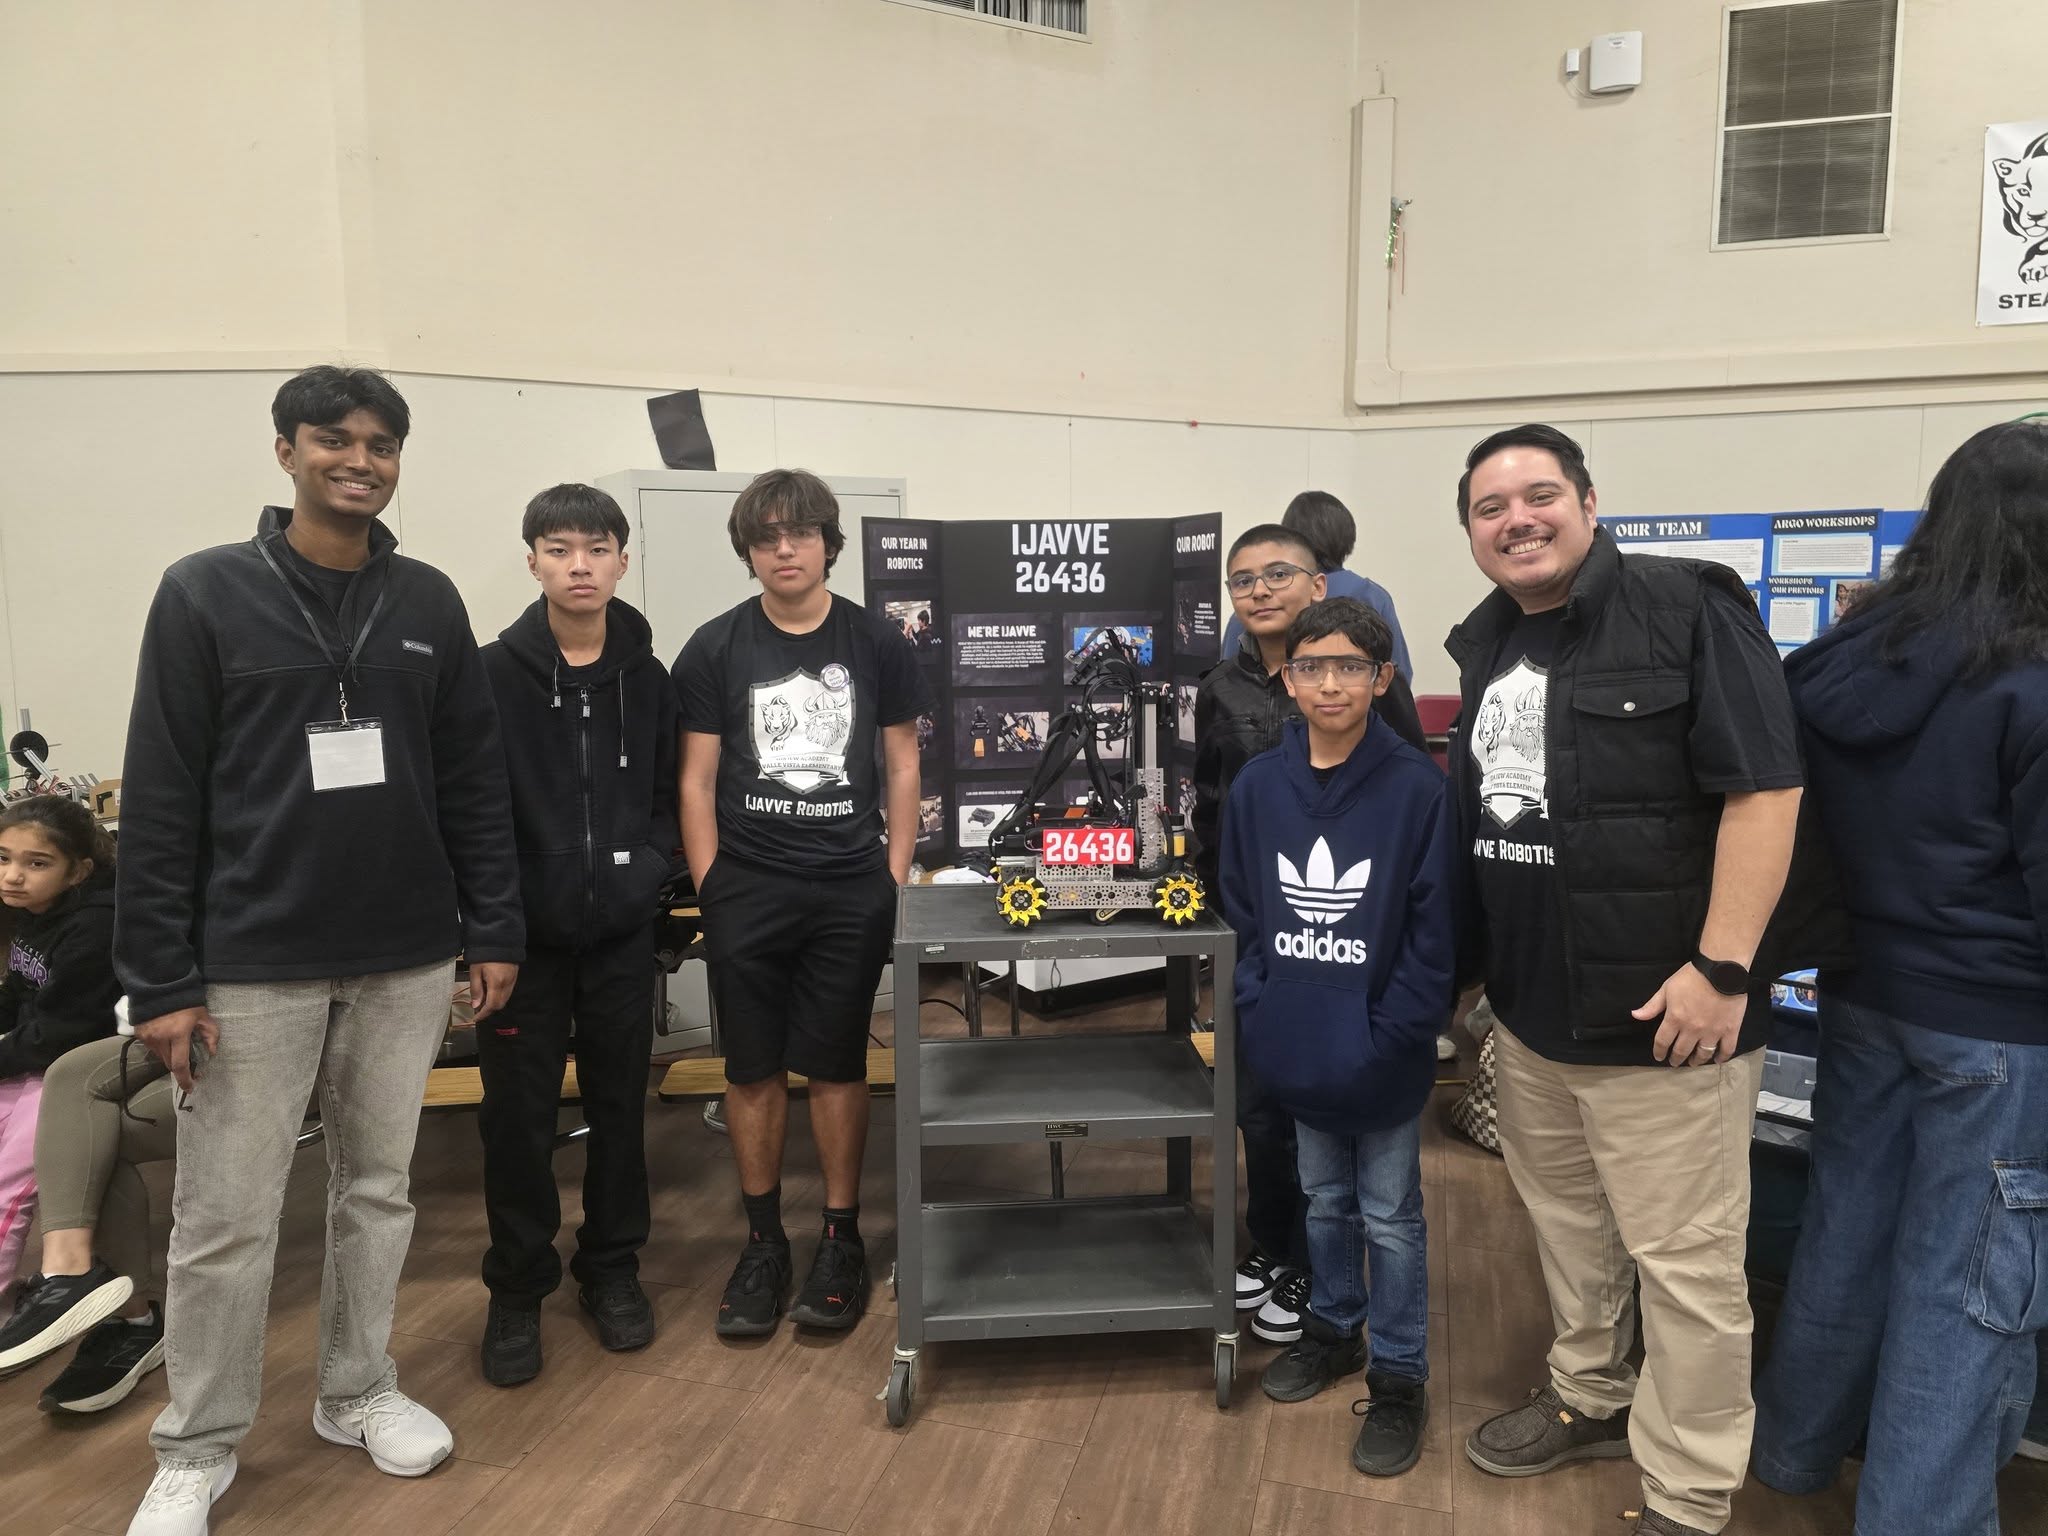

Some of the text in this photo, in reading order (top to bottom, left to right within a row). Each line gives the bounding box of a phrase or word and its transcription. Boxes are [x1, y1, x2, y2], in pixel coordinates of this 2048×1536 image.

[1615, 523, 1650, 537] OUR
[1656, 521, 1702, 536] TEAM
[1773, 515, 1876, 529] ARGO WORKSHOPS
[881, 537, 928, 550] OUR YEAR IN
[1012, 523, 1110, 555] IJAVVE
[1176, 533, 1216, 553] OUR ROBOT
[887, 557, 924, 570] ROBOTICS
[1016, 561, 1105, 593] 26436
[1768, 577, 1813, 585] WORKSHOPS
[1771, 586, 1825, 595] OUR PREVIOUS
[967, 625, 1037, 638] WE'RE IJAVVE
[745, 794, 854, 817] IJAVVE ROBOTICS
[1046, 832, 1131, 862] 26436
[1275, 928, 1367, 965] adidas
